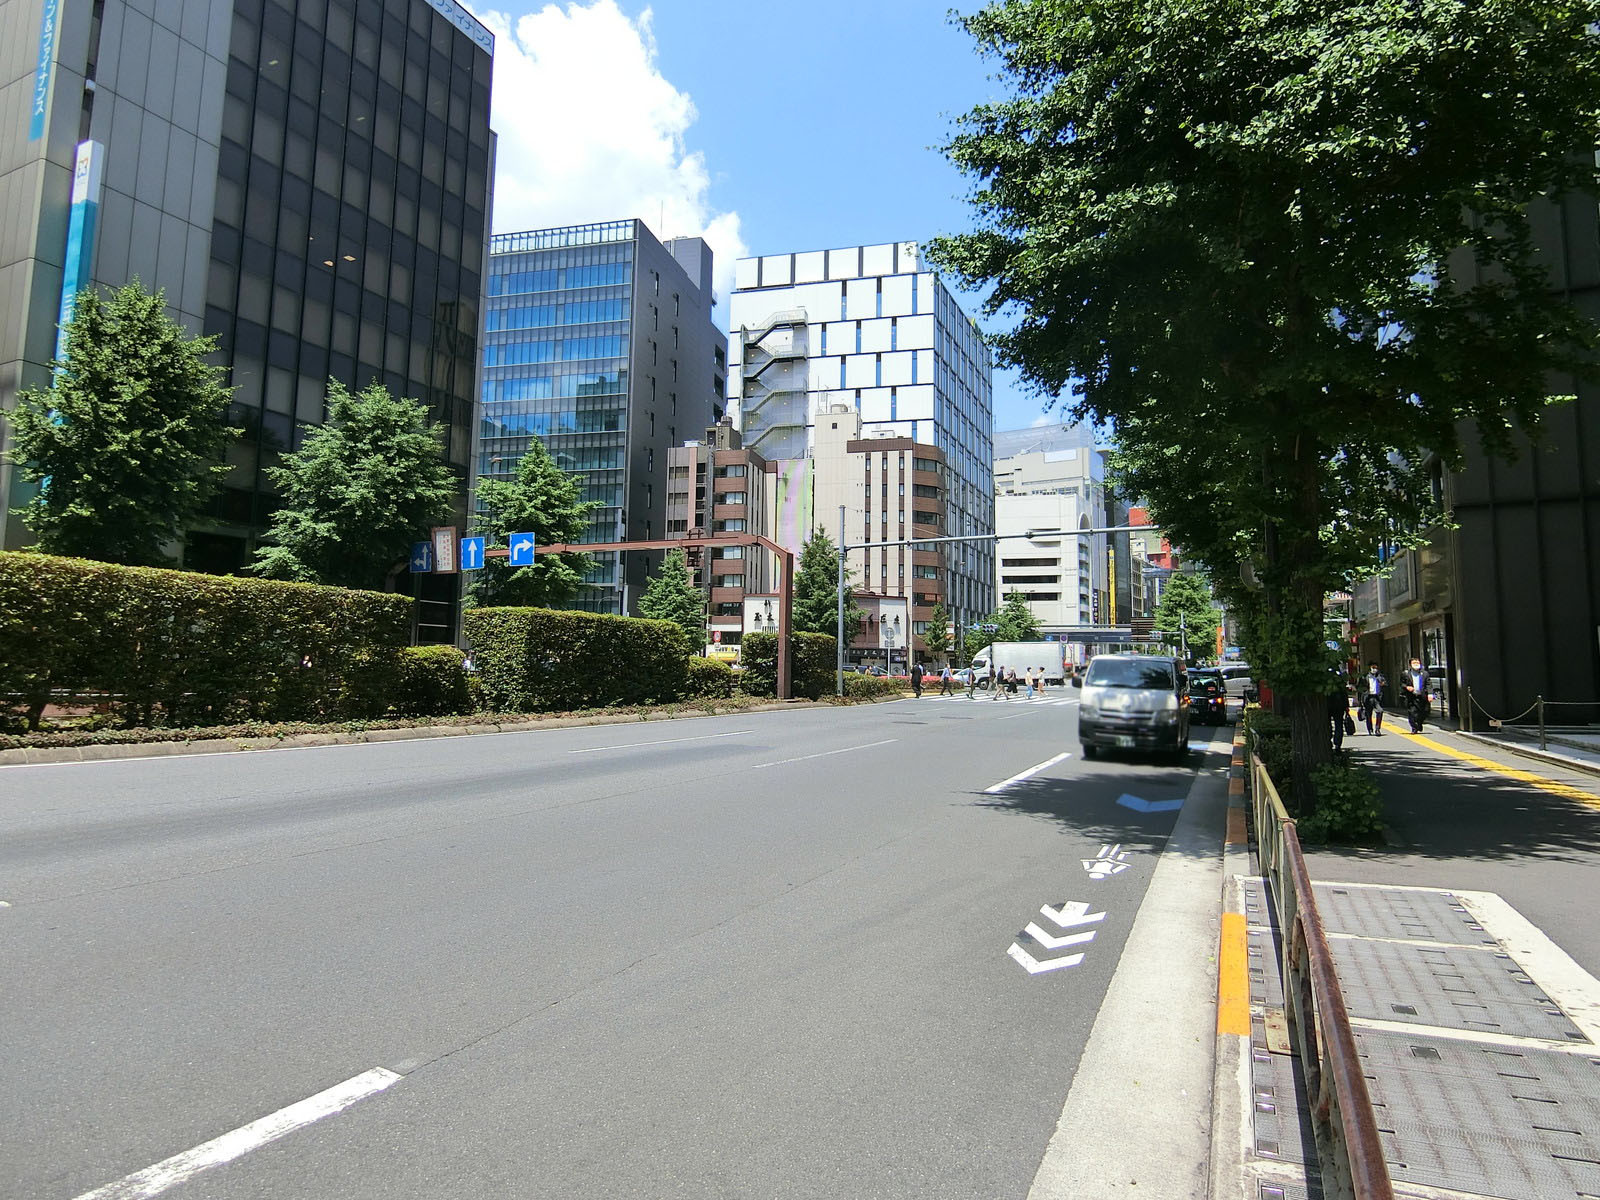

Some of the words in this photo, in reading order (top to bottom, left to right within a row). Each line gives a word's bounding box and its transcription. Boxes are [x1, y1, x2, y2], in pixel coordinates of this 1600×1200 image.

[35, 0, 56, 116] ン&ファイナンス
